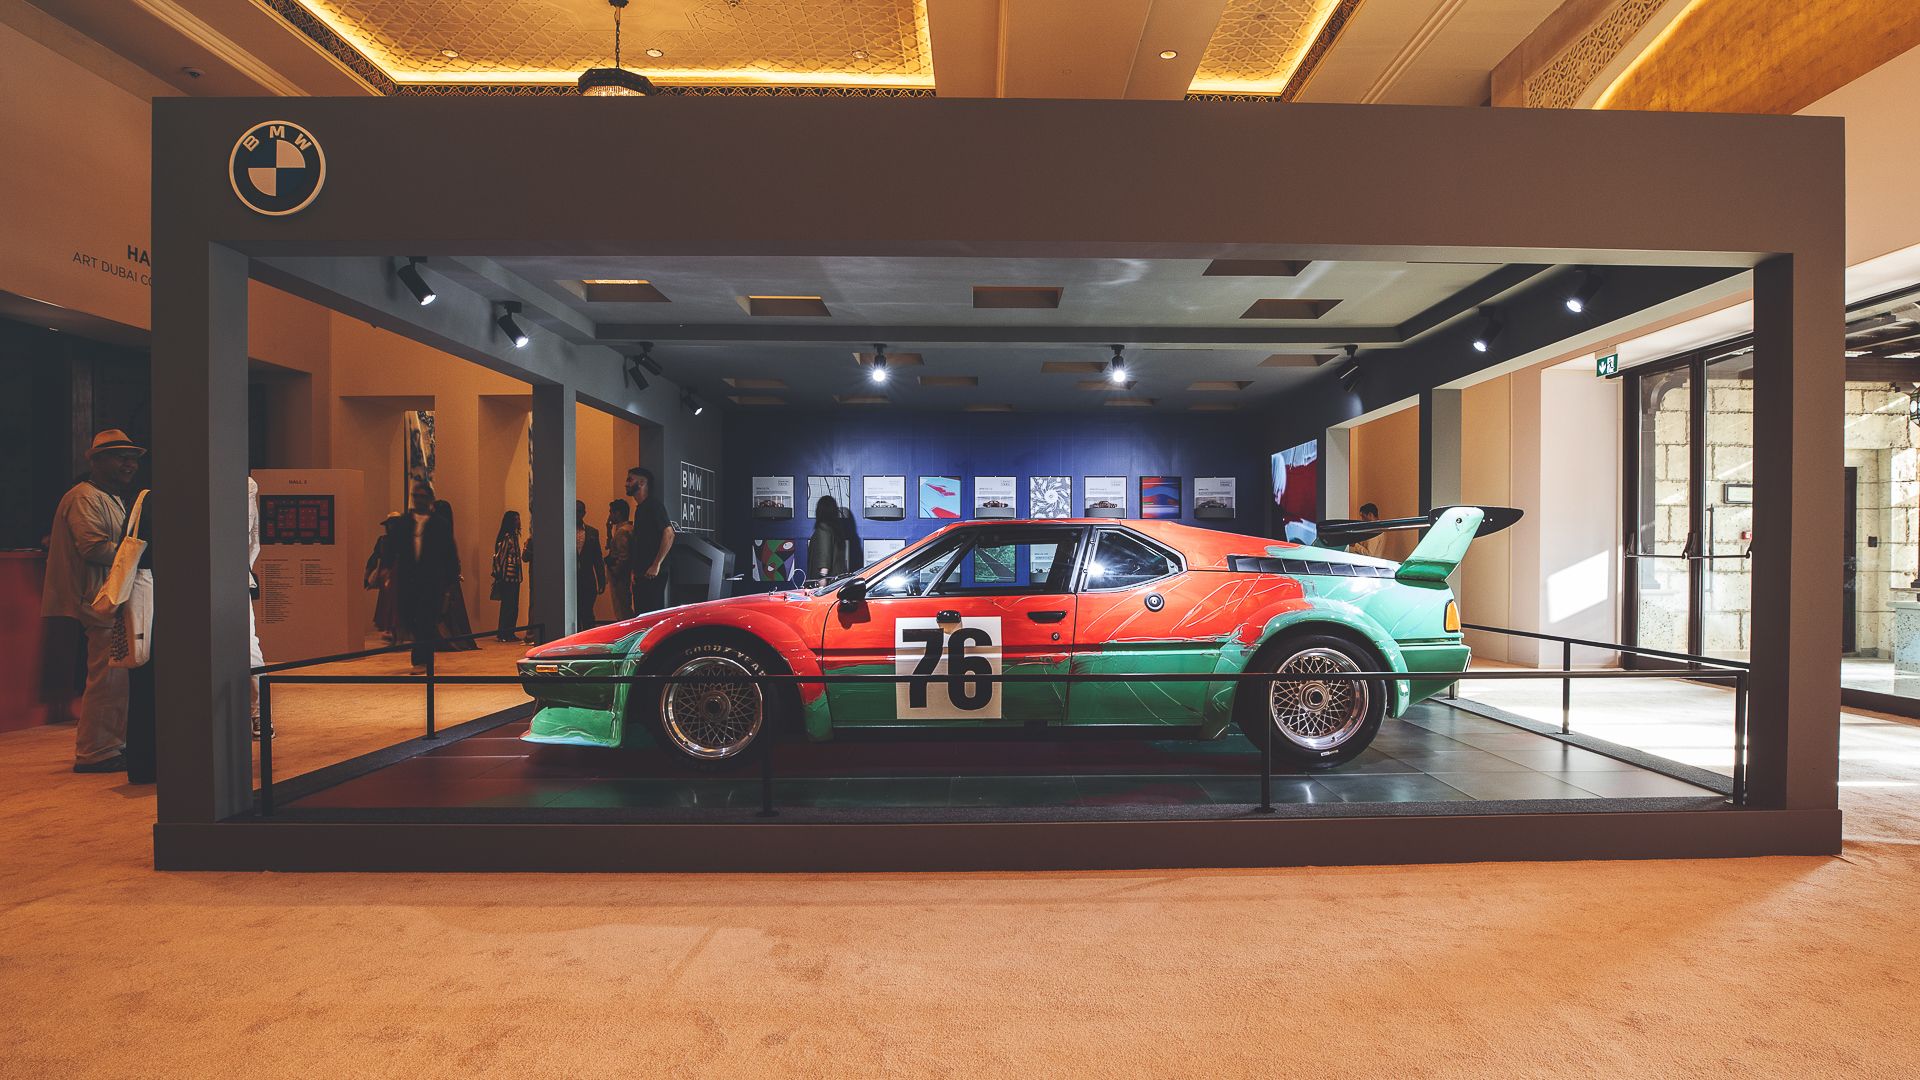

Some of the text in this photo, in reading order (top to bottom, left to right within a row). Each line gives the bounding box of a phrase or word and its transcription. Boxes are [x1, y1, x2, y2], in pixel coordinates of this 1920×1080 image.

[242, 125, 312, 152] BMW
[72, 251, 98, 269] ART
[101, 260, 138, 282] DUBAI
[682, 470, 702, 492] BMW
[682, 502, 701, 522] ART
[902, 627, 993, 711] 76
